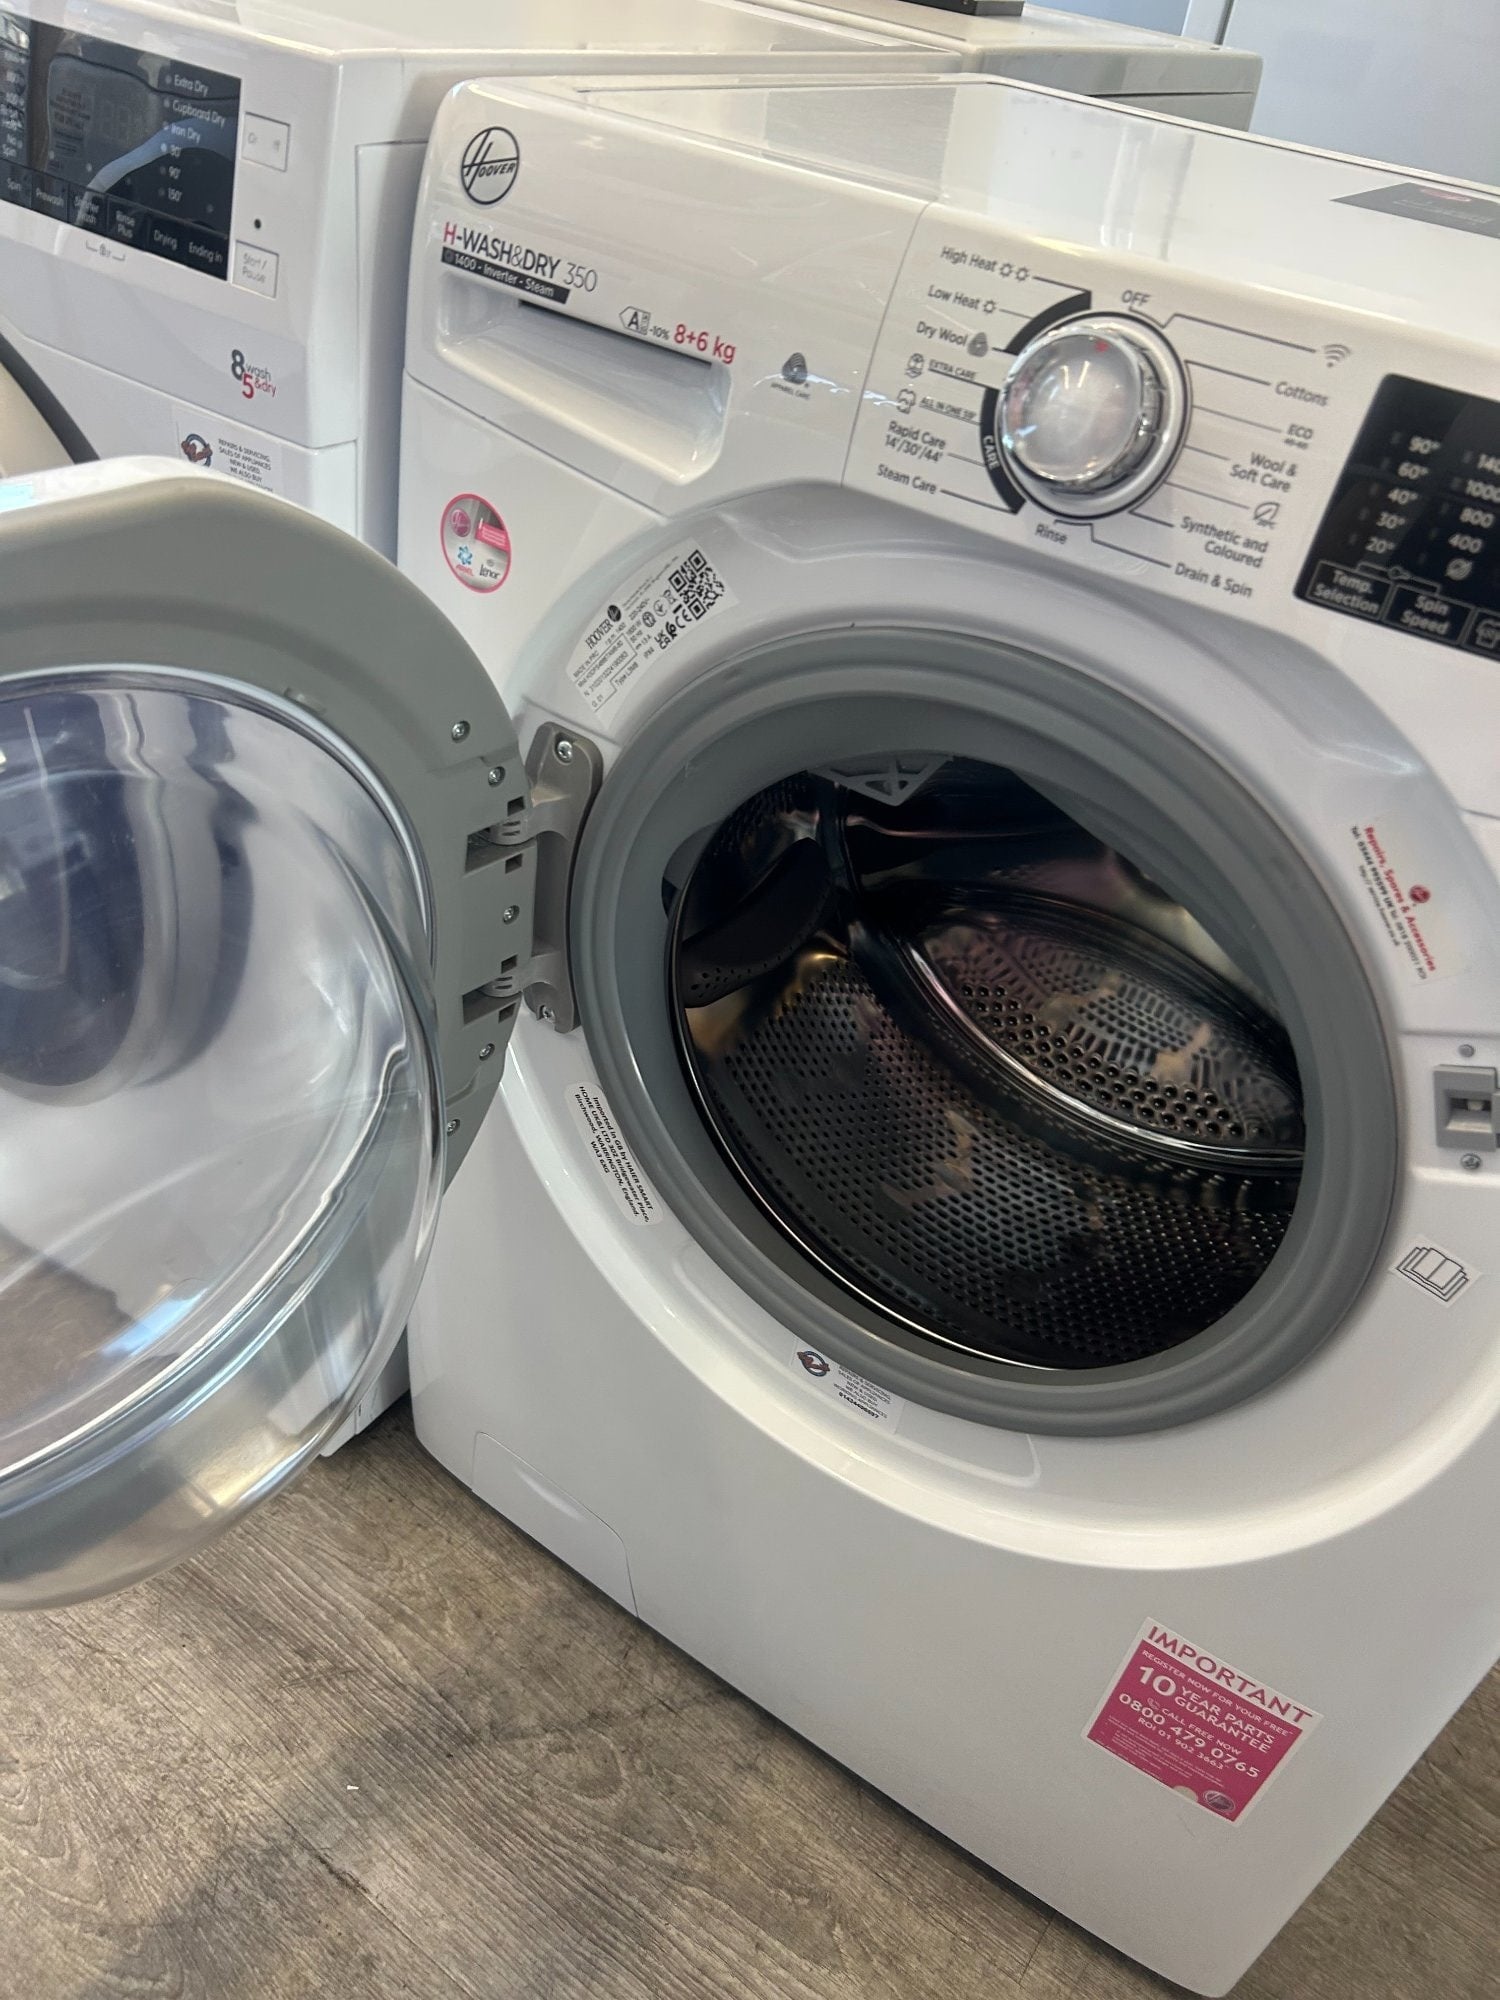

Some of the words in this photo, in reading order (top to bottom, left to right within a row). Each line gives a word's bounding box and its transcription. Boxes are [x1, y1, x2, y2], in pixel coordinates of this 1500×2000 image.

[174, 74, 193, 90] Extra
[194, 80, 208, 97] Dry
[172, 100, 211, 120] Cupboard
[211, 111, 226, 127] Dry
[171, 123, 186, 137] Iron
[187, 127, 201, 143] Dry
[153, 229, 178, 251] Drying
[188, 241, 214, 263] Ending
[940, 246, 967, 265] High
[970, 254, 998, 273] Heat
[454, 253, 478, 271] 1400
[483, 264, 518, 286] Inverter
[525, 277, 555, 299] Steam
[563, 261, 598, 293] 350
[927, 284, 952, 303] Low
[952, 292, 980, 311] Heat
[1121, 290, 1151, 305] OFF
[674, 323, 708, 352] 8+6
[713, 336, 736, 365] kg
[916, 321, 936, 340] Dry
[939, 329, 968, 347] Wool
[231, 349, 245, 380] 8
[245, 363, 272, 382] wash
[242, 373, 254, 399] 5
[1275, 381, 1329, 408] Cottons
[888, 421, 920, 442] Rapid
[921, 433, 947, 450] Care
[1287, 423, 1314, 441] ECO
[983, 435, 1001, 470] CARE
[1250, 451, 1286, 473] Wool
[1286, 463, 1298, 478] &
[877, 463, 909, 485] Steam
[911, 477, 937, 495] Care
[1229, 463, 1257, 482] Soft
[1260, 474, 1291, 493] Care
[1459, 507, 1495, 529] 800
[1034, 523, 1068, 545] Rinse
[1180, 516, 1240, 546] Synthetic
[1242, 537, 1269, 554] and
[1448, 533, 1483, 554] 400
[1204, 540, 1264, 568] Coloured
[1174, 562, 1210, 584] Drain
[1211, 575, 1222, 588] &
[1223, 578, 1253, 599] Spin
[1331, 570, 1373, 594] Temp.
[1314, 584, 1380, 614] Selection
[1415, 595, 1449, 616] Spin
[585, 618, 613, 649] HOOVER
[1401, 609, 1449, 635] Speed
[1384, 869, 1403, 903] Spares
[1405, 916, 1436, 971] Accessories
[575, 1094, 597, 1133] Birchwood,
[596, 1134, 624, 1186] WARRINGTON,
[622, 1187, 639, 1217] England.
[579, 1086, 594, 1108] HOME
[601, 1130, 611, 1143] LTD
[616, 1158, 639, 1201] Bridgewater
[637, 1201, 649, 1222] Place,
[593, 1097, 613, 1130] Imported
[615, 1139, 623, 1151] GB
[620, 1151, 628, 1161] by
[626, 1161, 640, 1183] HAIER
[637, 1184, 654, 1210] SMART
[1142, 1650, 1186, 1679] REGISTER
[1187, 1676, 1212, 1693] NOW
[1212, 1690, 1233, 1707] FOR
[1235, 1704, 1262, 1723] YOUR
[1147, 1626, 1313, 1723] IMPORTANT
[1139, 1665, 1177, 1697] 10
[1181, 1685, 1221, 1716] YEAR
[1224, 1712, 1275, 1745] PARTS
[1119, 1692, 1166, 1726] 0800
[1170, 1725, 1206, 1749] 479
[1210, 1748, 1260, 1779] 0765
[1138, 1717, 1157, 1731] ROI
[1158, 1730, 1172, 1741] 01
[1174, 1739, 1195, 1754] 902
[1161, 1708, 1186, 1727] CALL
[1188, 1721, 1215, 1741] FREE
[1216, 1739, 1242, 1755] NOW
[1175, 1696, 1271, 1754] GUARANTEE
